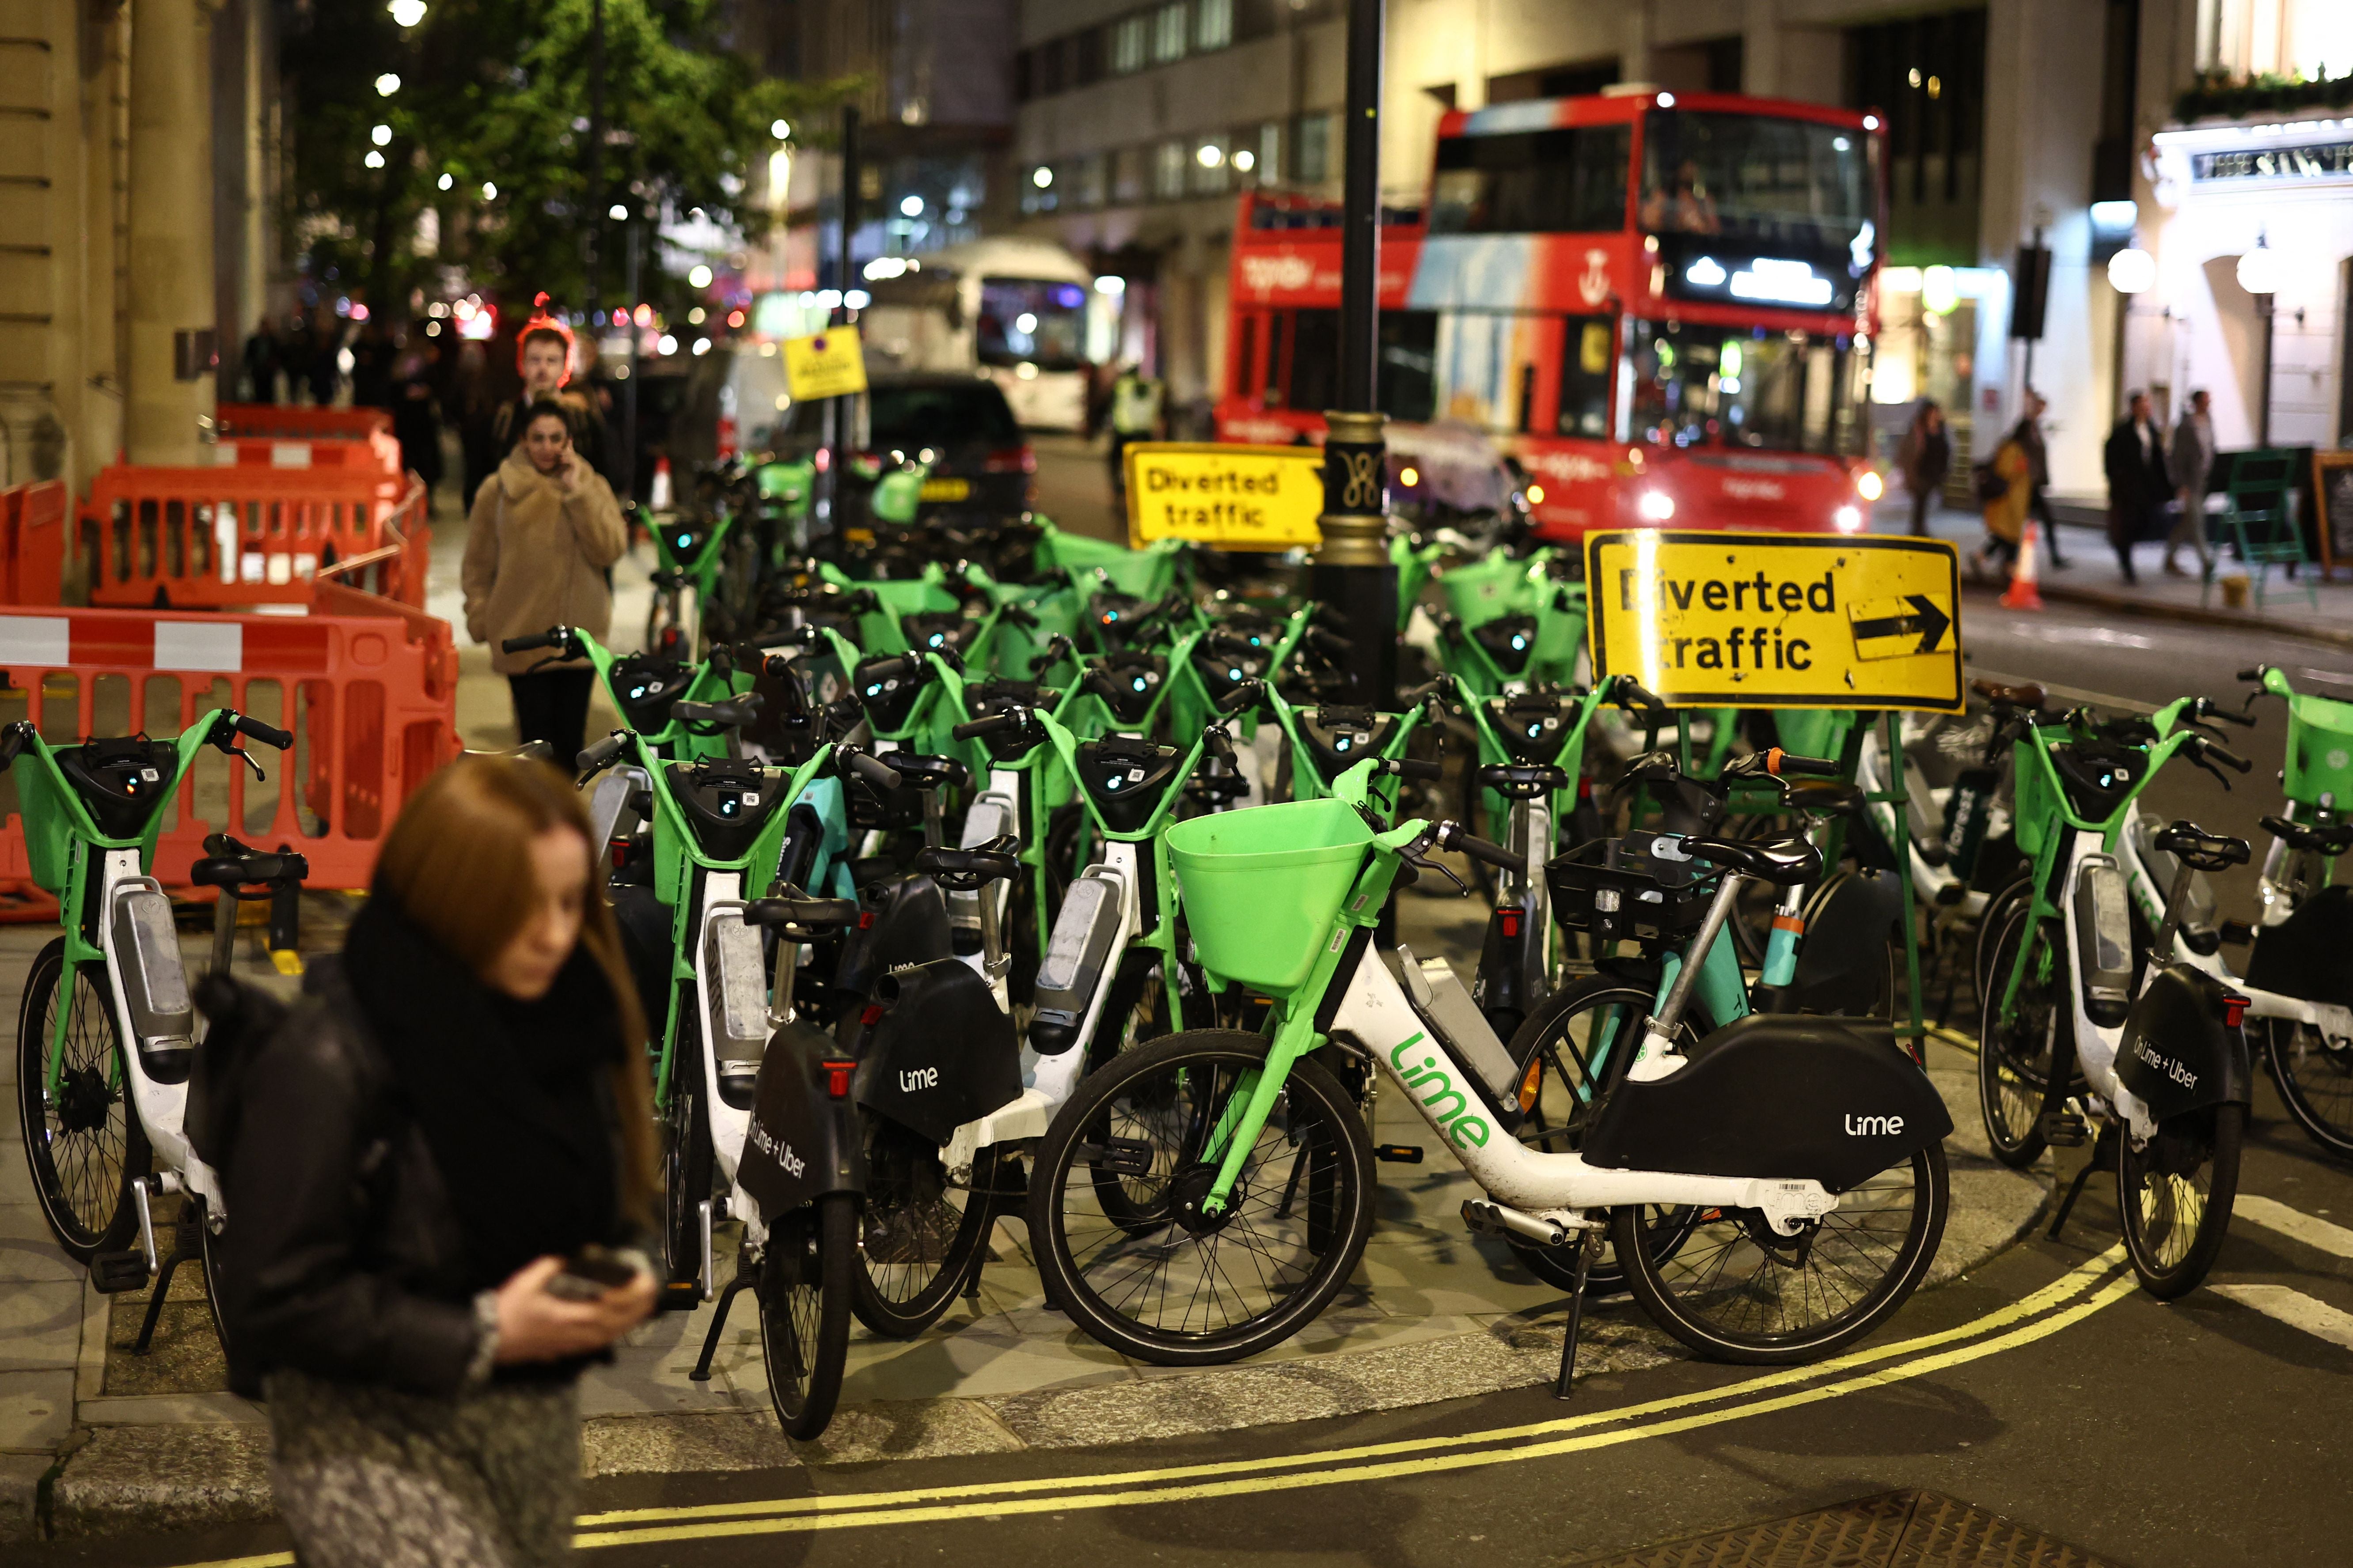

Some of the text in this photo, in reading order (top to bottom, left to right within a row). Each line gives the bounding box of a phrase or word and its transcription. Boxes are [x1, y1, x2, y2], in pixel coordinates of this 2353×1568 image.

[1147, 467, 1280, 495] Diverted
[1165, 501, 1264, 528] traffic
[899, 1067, 938, 1092] Lime
[2140, 1041, 2161, 1069] Lime
[2163, 1058, 2169, 1069] +
[2169, 1058, 2198, 1090] Uber
[1390, 1030, 1490, 1150] Lime
[1845, 1114, 1904, 1136] Lime
[754, 1119, 772, 1154] Lime
[774, 1140, 779, 1155] +
[779, 1141, 805, 1178] Uber
